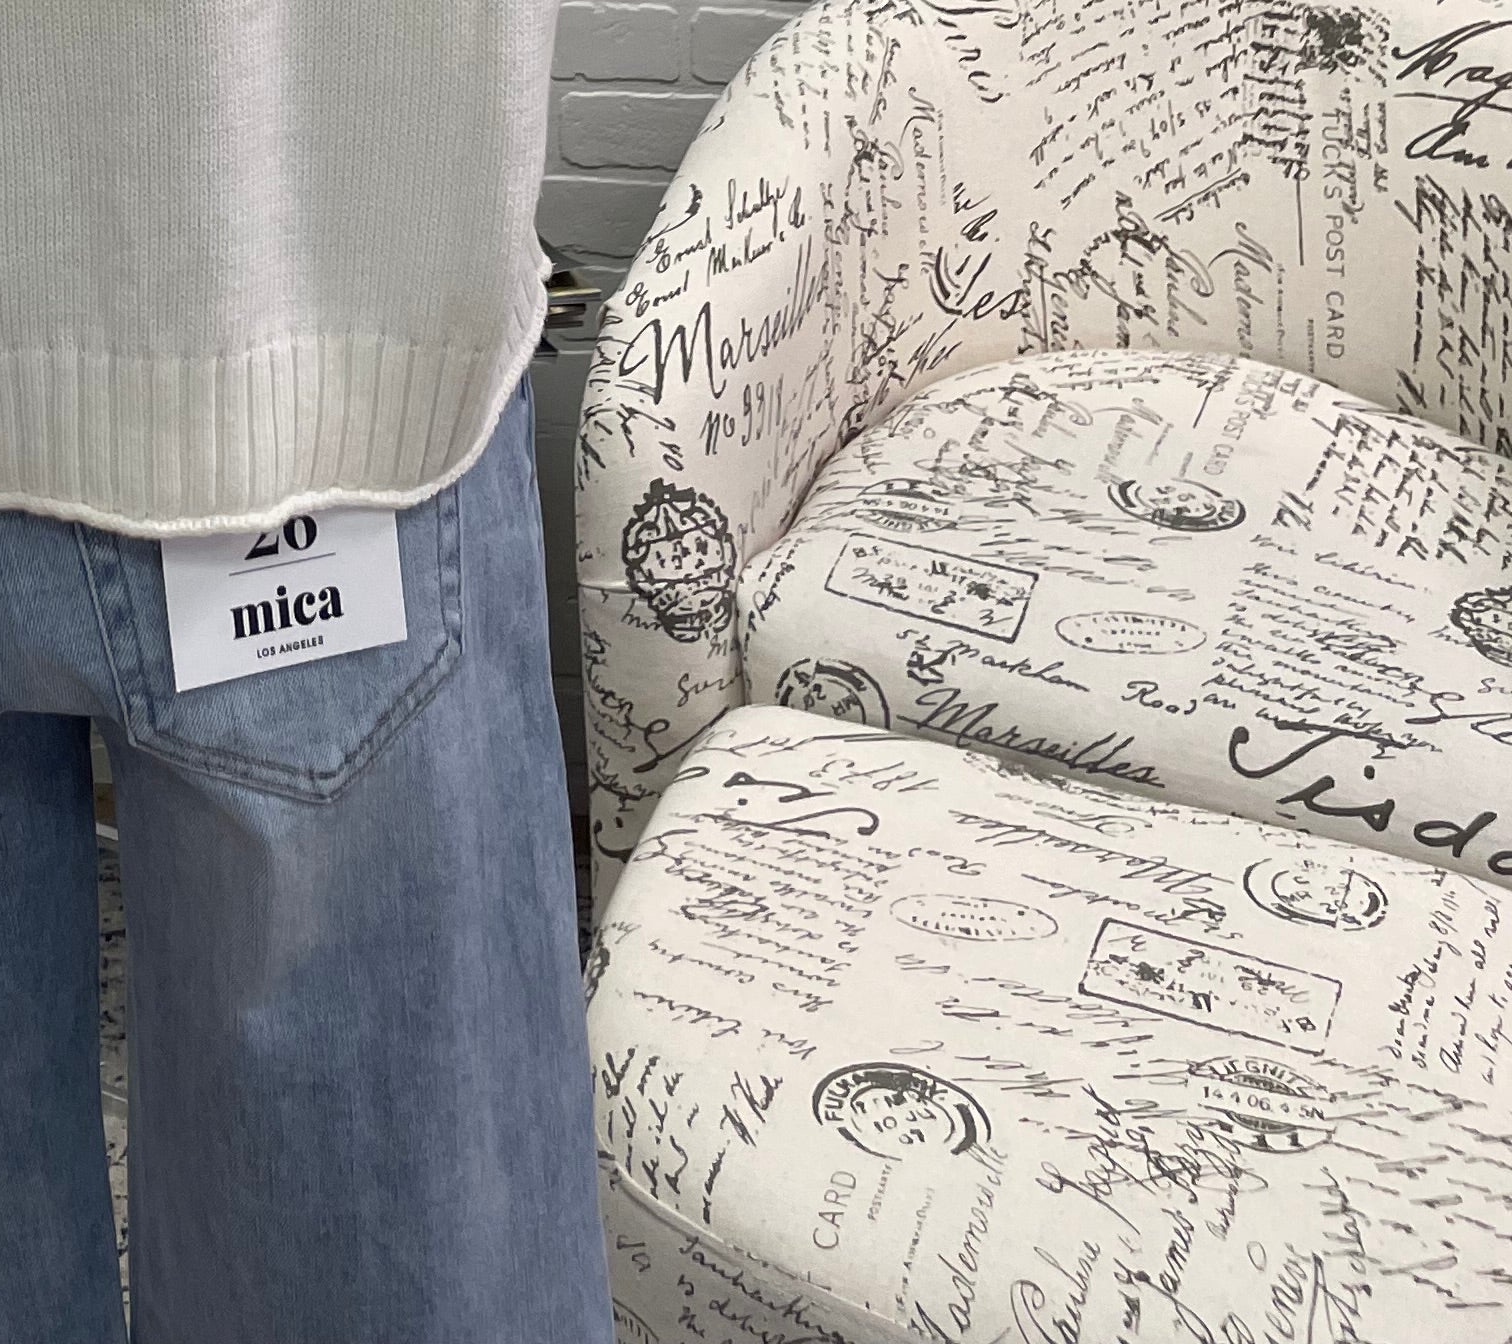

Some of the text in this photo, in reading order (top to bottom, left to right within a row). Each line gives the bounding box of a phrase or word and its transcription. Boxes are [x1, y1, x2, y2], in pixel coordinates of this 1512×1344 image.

[1324, 214, 1346, 277] POST
[1325, 290, 1346, 359] CARD
[230, 585, 345, 641] mica
[256, 636, 324, 659] LOS ANGELES
[812, 1168, 858, 1251] CARD
